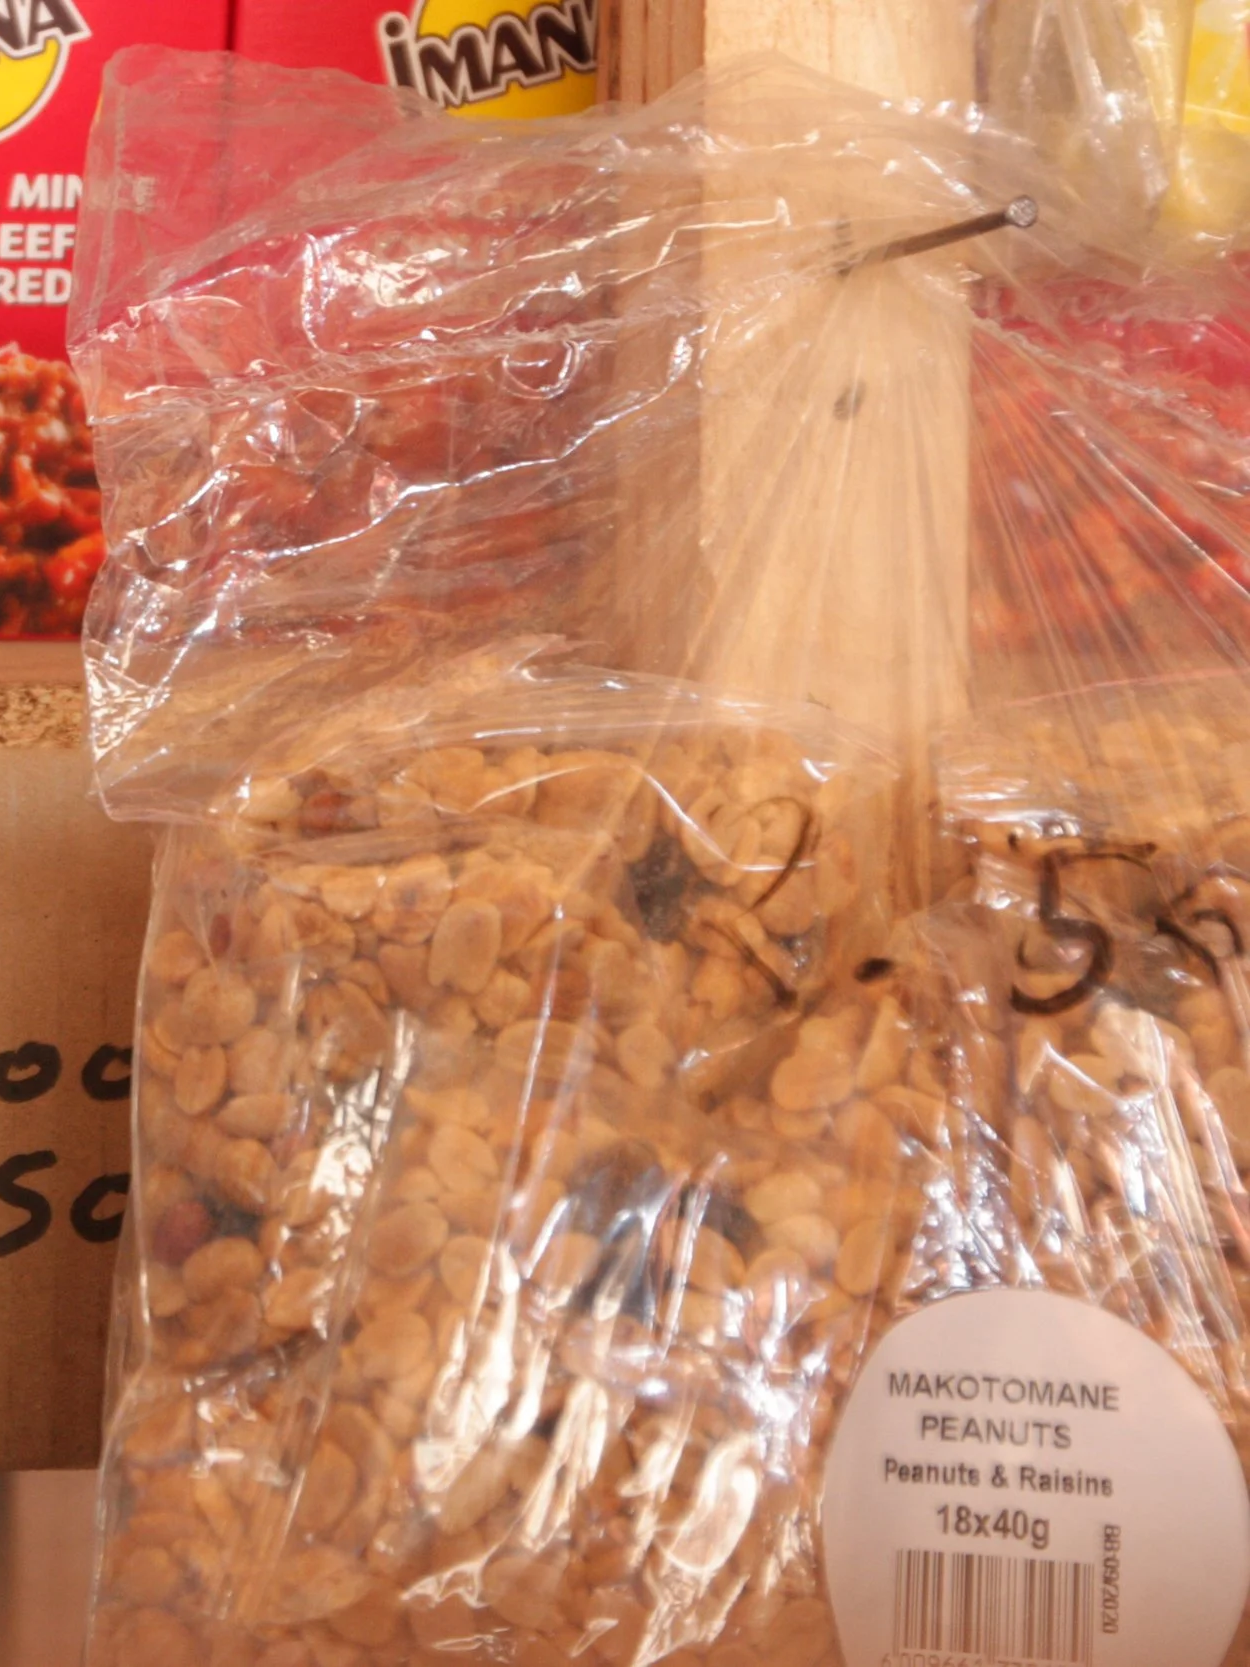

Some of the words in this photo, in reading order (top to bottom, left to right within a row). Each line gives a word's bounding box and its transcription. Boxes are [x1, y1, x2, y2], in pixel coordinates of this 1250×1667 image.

[888, 1372, 1120, 1412] MAKOTOMANE
[920, 1415, 1072, 1449] PEANUTS
[884, 1457, 981, 1488] Peanuts
[990, 1467, 1008, 1489] &
[1019, 1466, 1115, 1498] Raisins
[936, 1504, 1051, 1550] 18x40g
